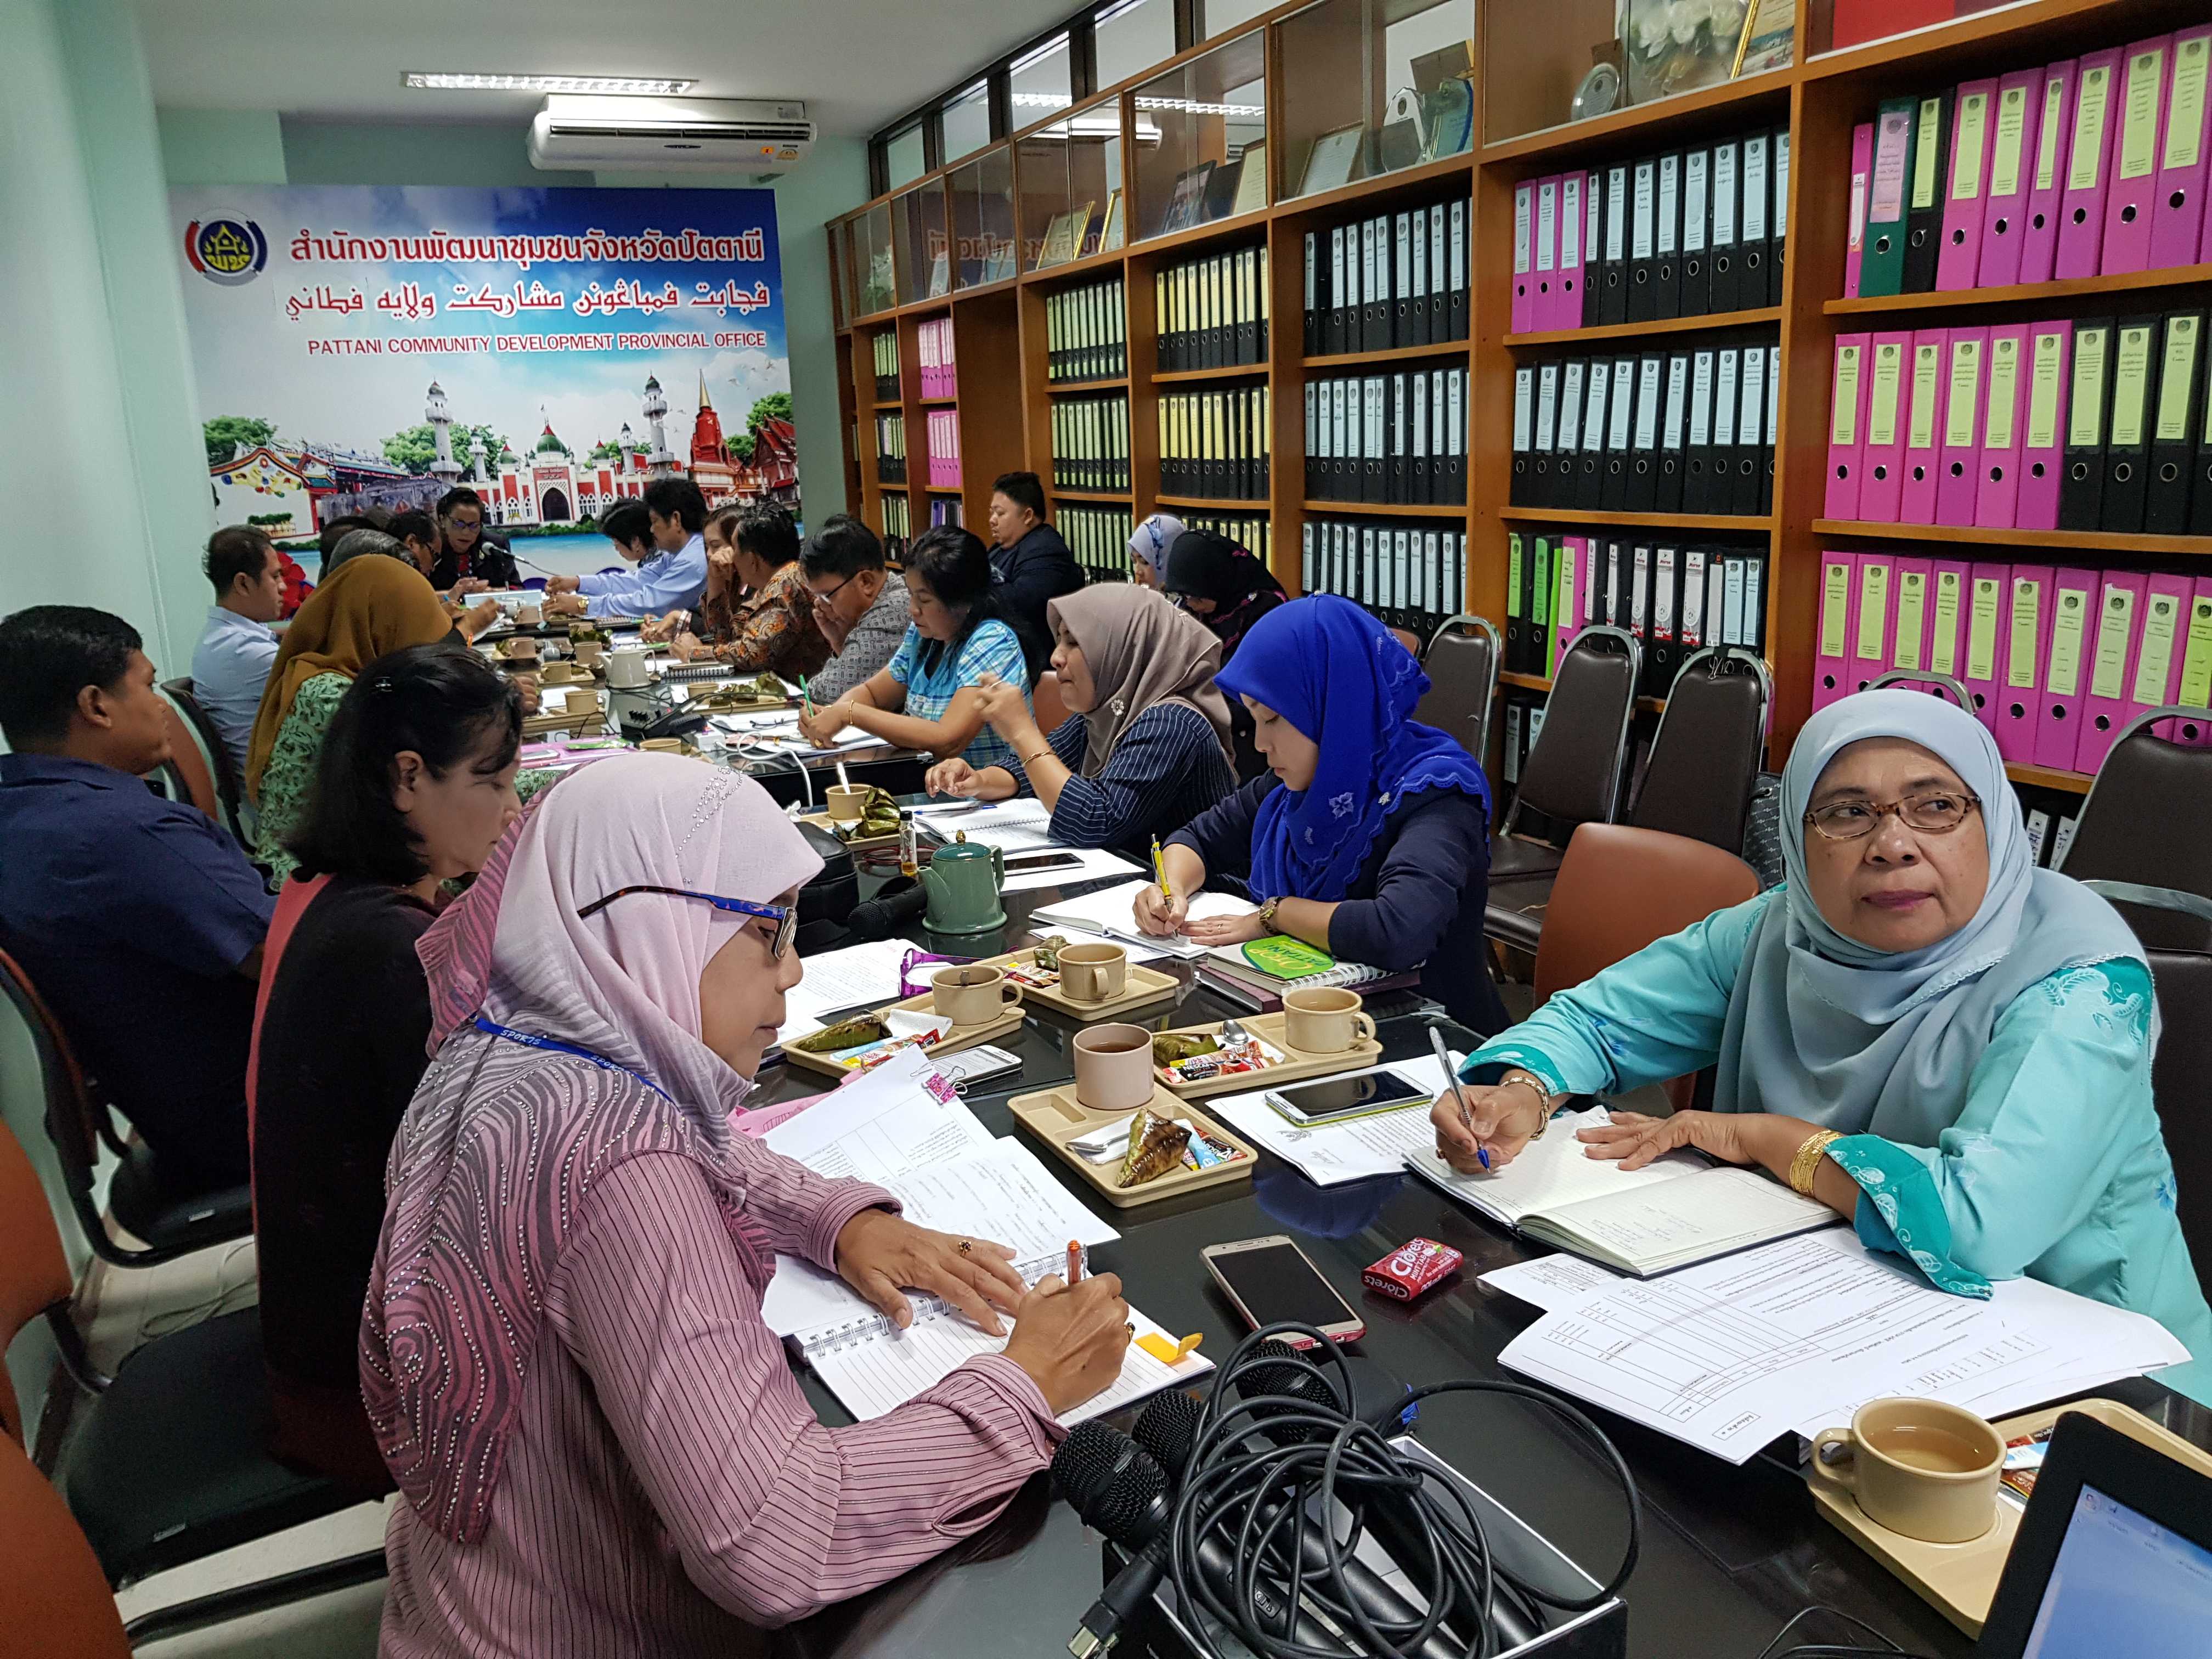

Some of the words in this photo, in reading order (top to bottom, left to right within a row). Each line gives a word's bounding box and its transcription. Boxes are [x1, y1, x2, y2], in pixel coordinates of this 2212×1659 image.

[290, 228, 763, 268] สำนักงานพัฒนาชุมชนจังหวัดปัตตานี
[447, 283, 562, 316] مشاركت
[690, 281, 769, 315] فجابت
[308, 339, 382, 355] PATTANI
[388, 337, 490, 353] COMMUNITY
[498, 335, 612, 350] DEVELOPMENT
[619, 332, 709, 348] PROVINCIAL
[715, 332, 765, 347] OFFICE
[1248, 948, 1314, 970] OTOP
[1262, 945, 1331, 966] PATTANI
[500, 1029, 542, 1045] SPORTS
[1390, 1238, 1425, 1276] Clorets
[1409, 1263, 1421, 1280] MINT
[1418, 1254, 1427, 1268] TAB
[1364, 1275, 1408, 1299] Clorets
